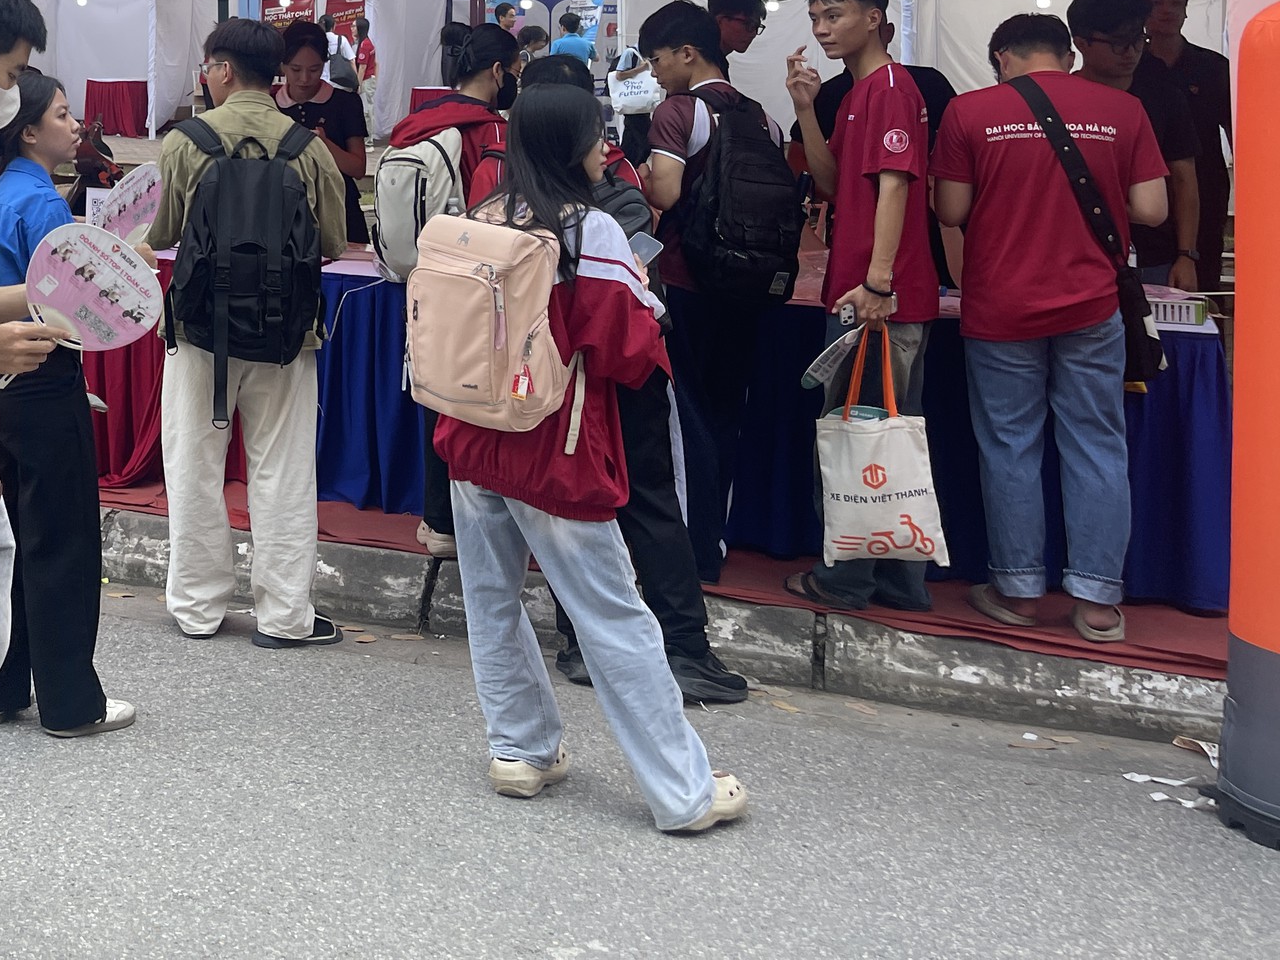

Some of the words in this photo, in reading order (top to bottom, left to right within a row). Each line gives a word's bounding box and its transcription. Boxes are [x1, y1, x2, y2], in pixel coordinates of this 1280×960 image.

[619, 90, 649, 98] Future
[985, 125, 1001, 135] ĐẠI
[1003, 123, 1025, 132] HỌC
[1027, 121, 1043, 131] BÁ
[1085, 123, 1099, 131] HÀ
[1101, 126, 1117, 135] NỘI
[79, 234, 100, 254] DOANH
[119, 251, 138, 270] YADEA
[830, 493, 841, 501] XE
[843, 494, 868, 504] ĐIỆN
[870, 494, 893, 504] VIỆT
